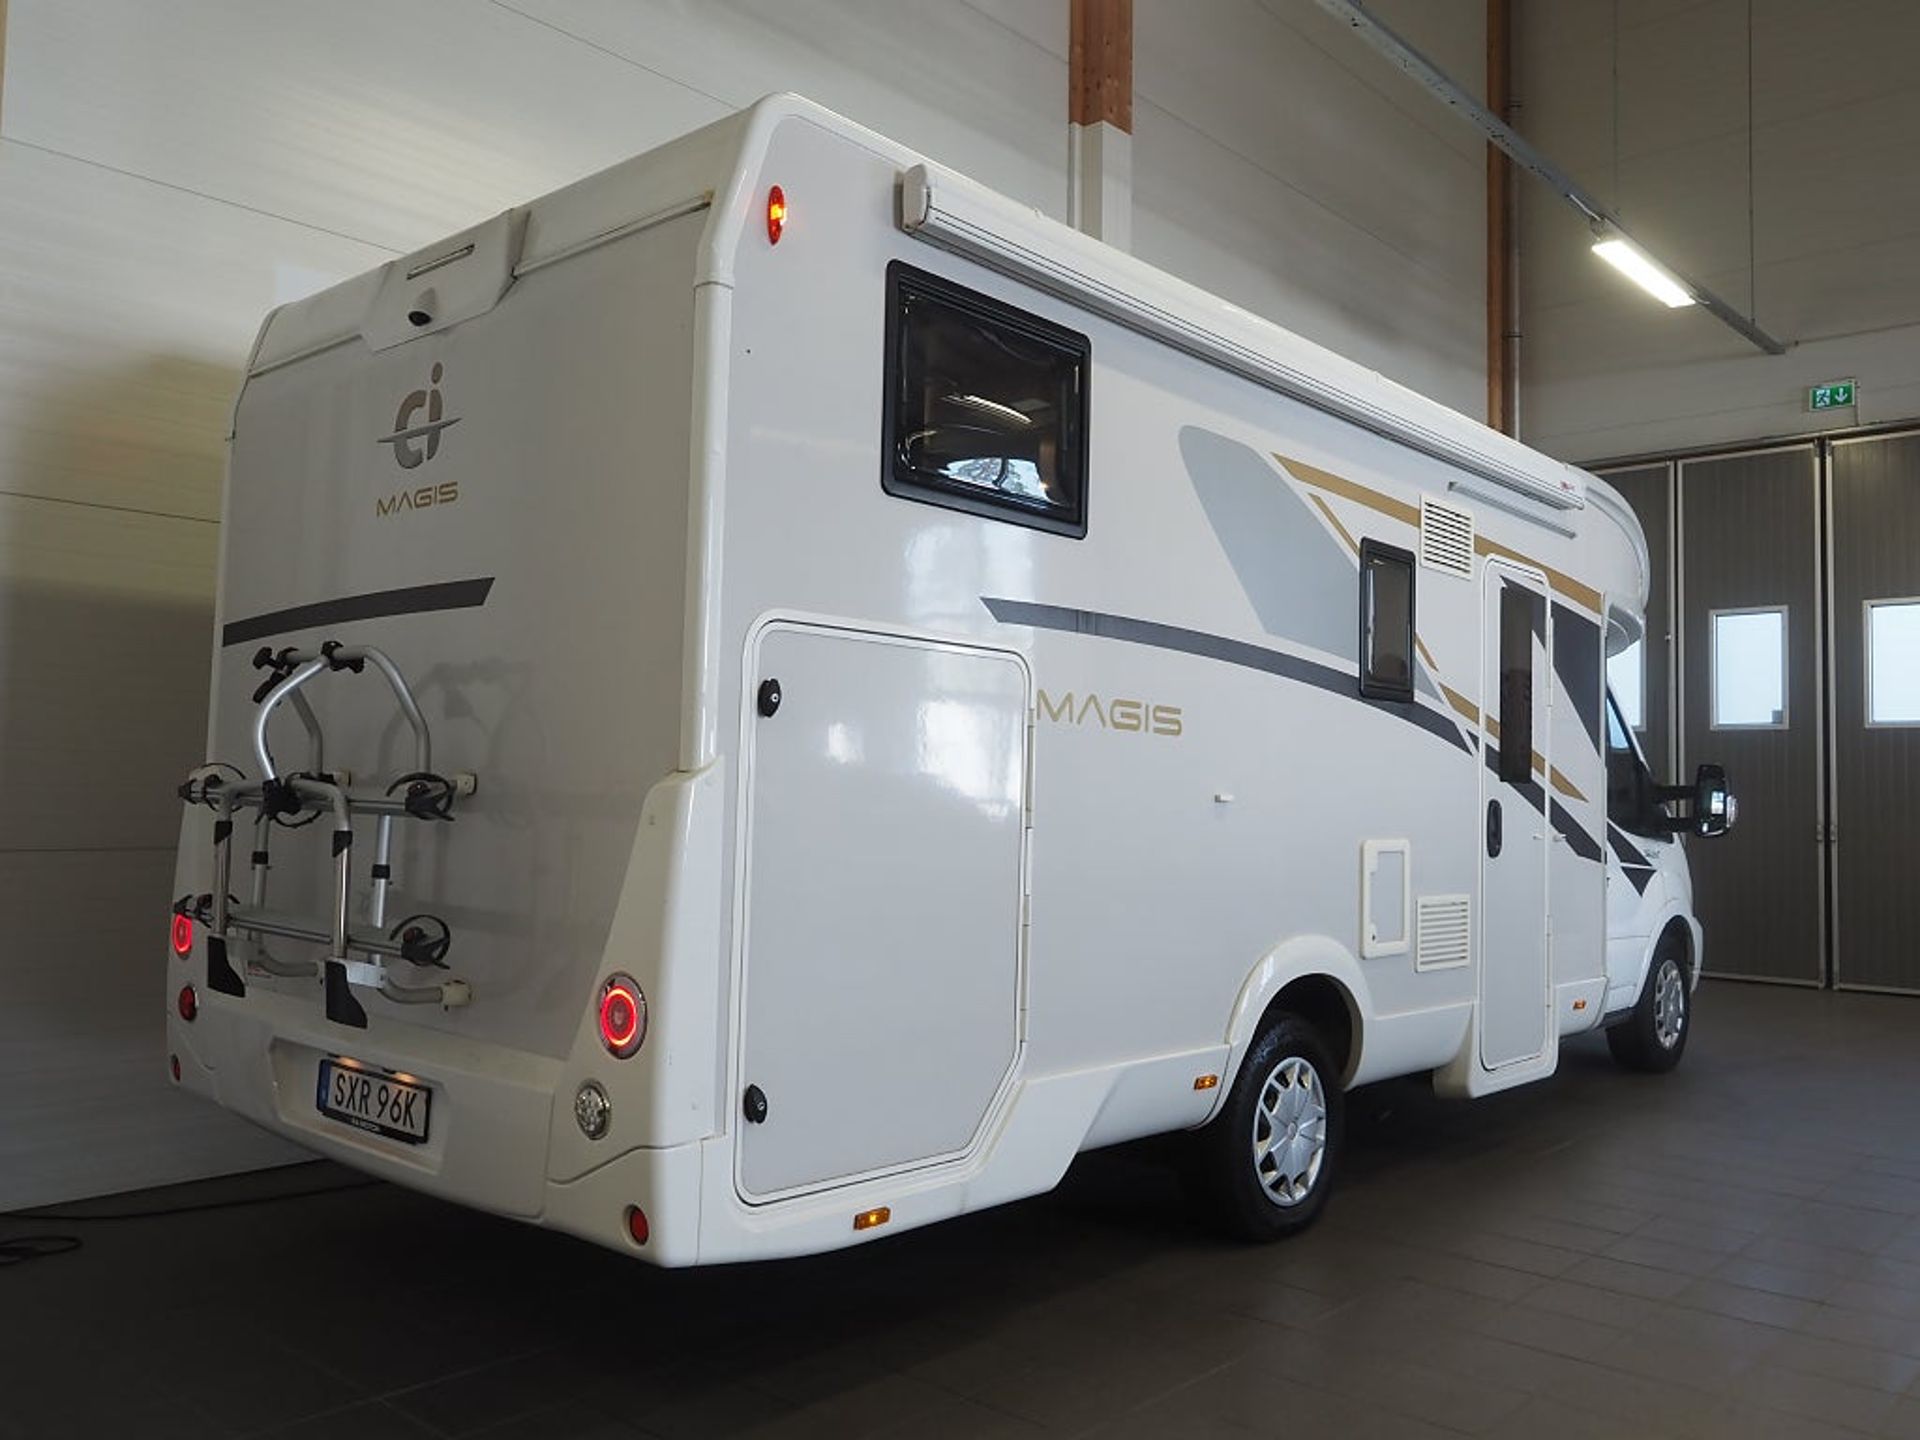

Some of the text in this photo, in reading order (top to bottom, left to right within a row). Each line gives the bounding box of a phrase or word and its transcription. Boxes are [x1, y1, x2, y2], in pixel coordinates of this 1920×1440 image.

[376, 481, 459, 518] MAGIS
[1036, 689, 1182, 737] MAGIS
[335, 1073, 371, 1116] SXR
[377, 1084, 418, 1130] 96K
